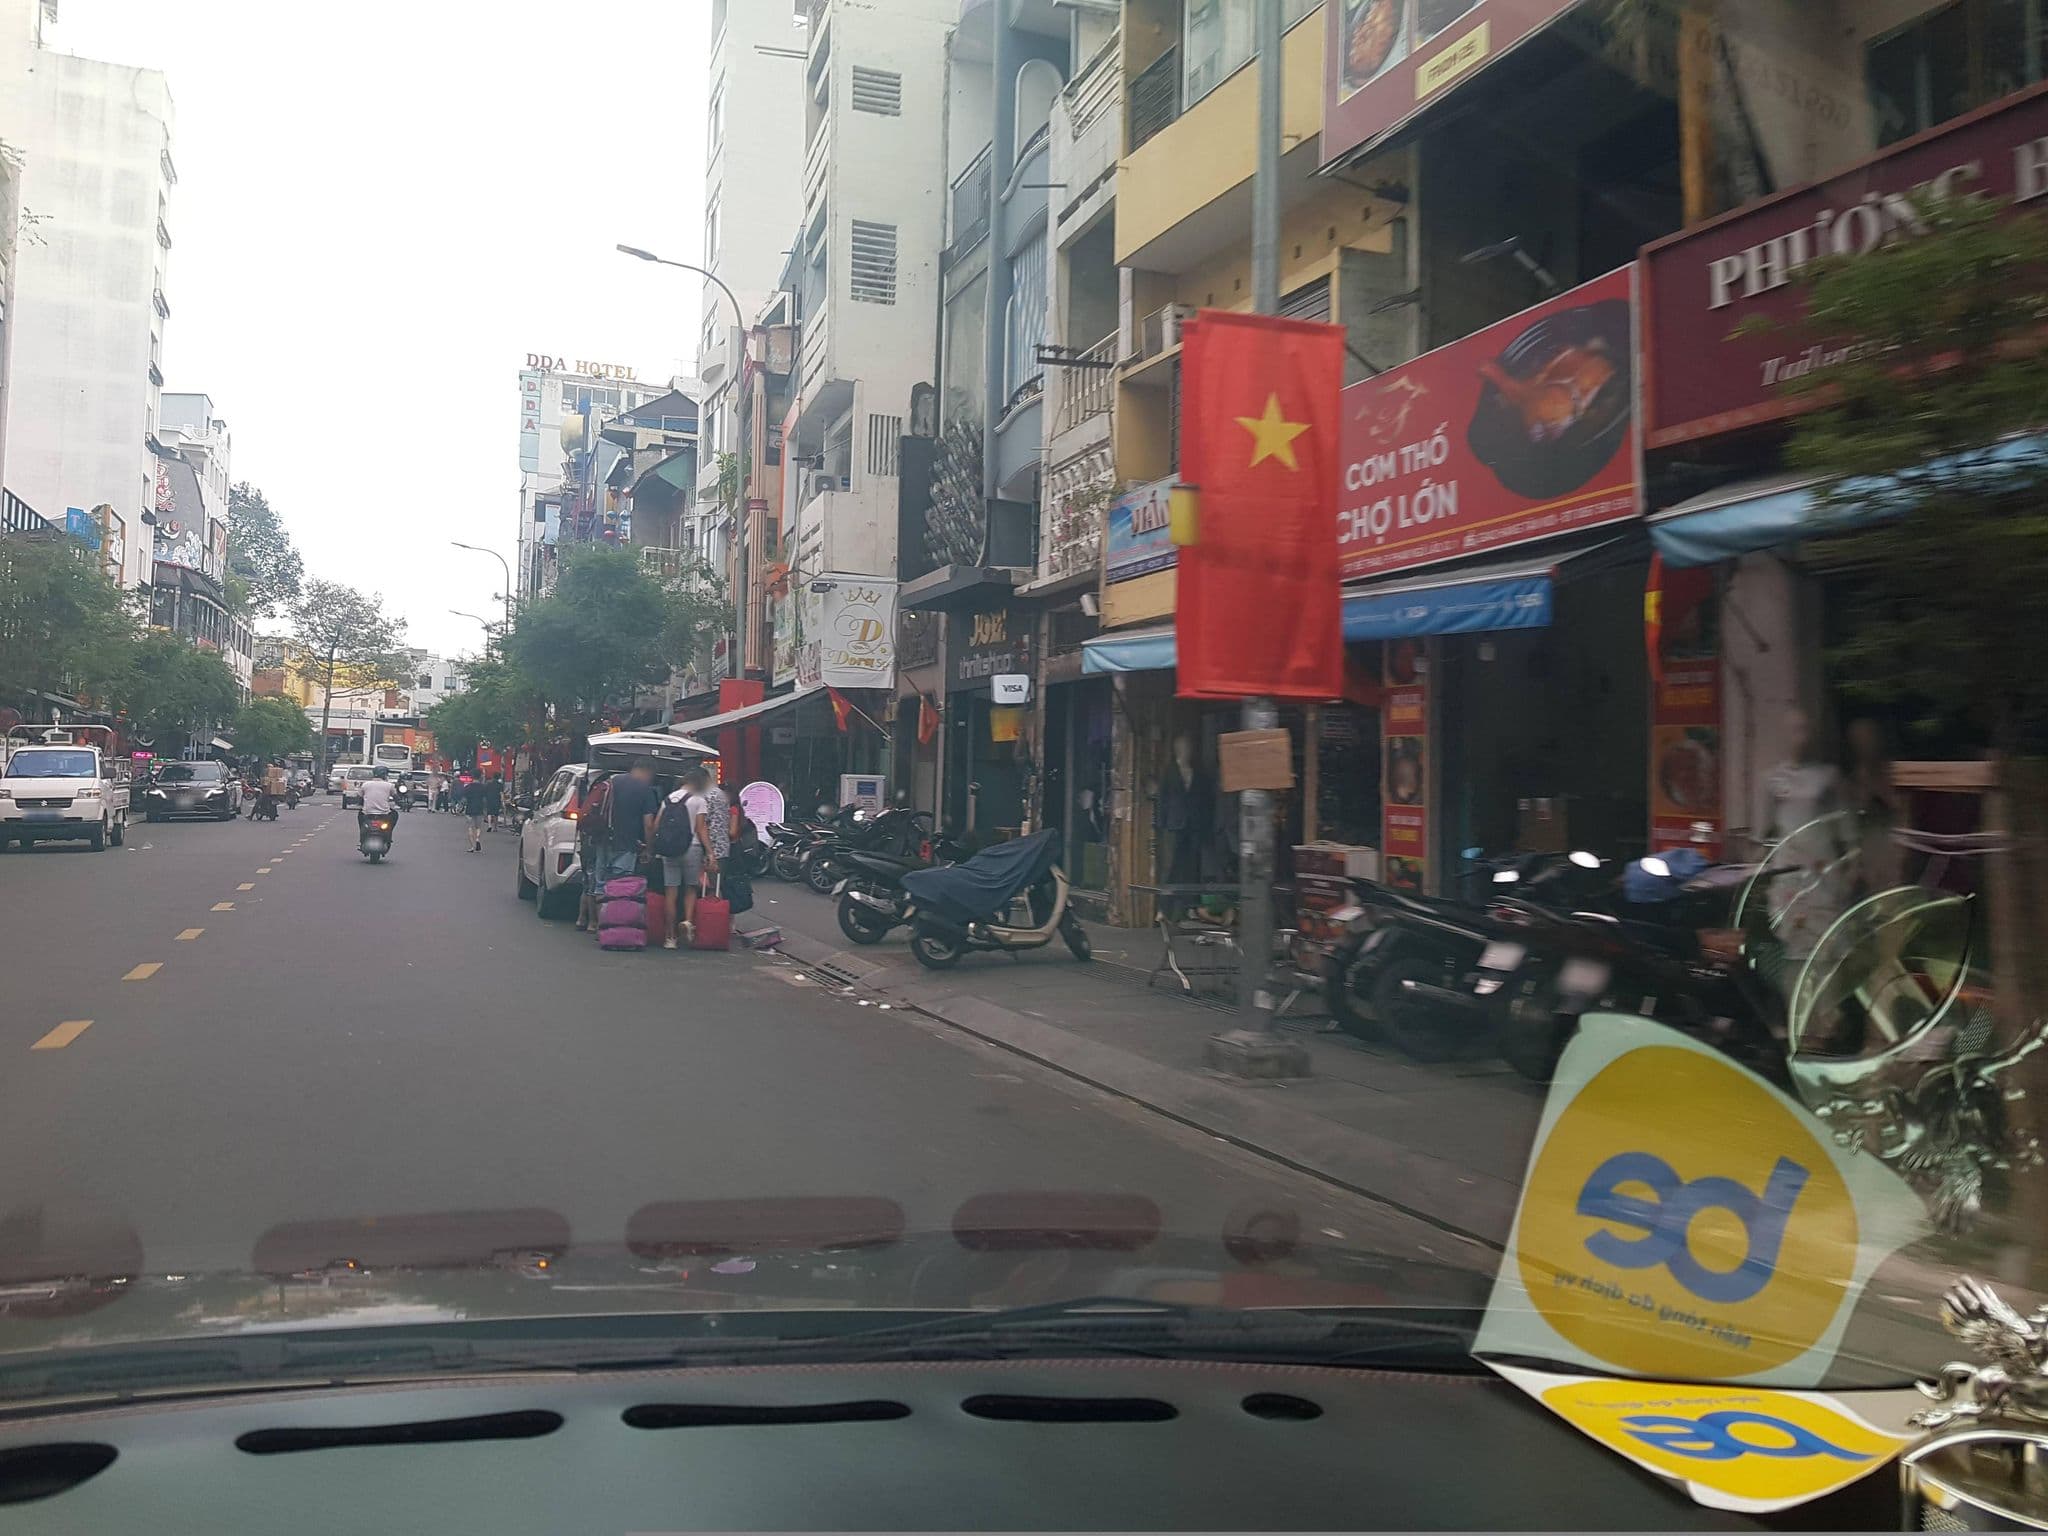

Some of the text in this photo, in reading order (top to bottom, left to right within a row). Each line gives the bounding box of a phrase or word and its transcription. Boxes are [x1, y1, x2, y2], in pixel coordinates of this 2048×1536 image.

[526, 352, 637, 381] DDA HOTEL
[525, 381, 537, 430] DDA
[1345, 451, 1397, 491] CƠM
[1398, 477, 1458, 528] LỚN
[1001, 684, 1024, 693] VISA
